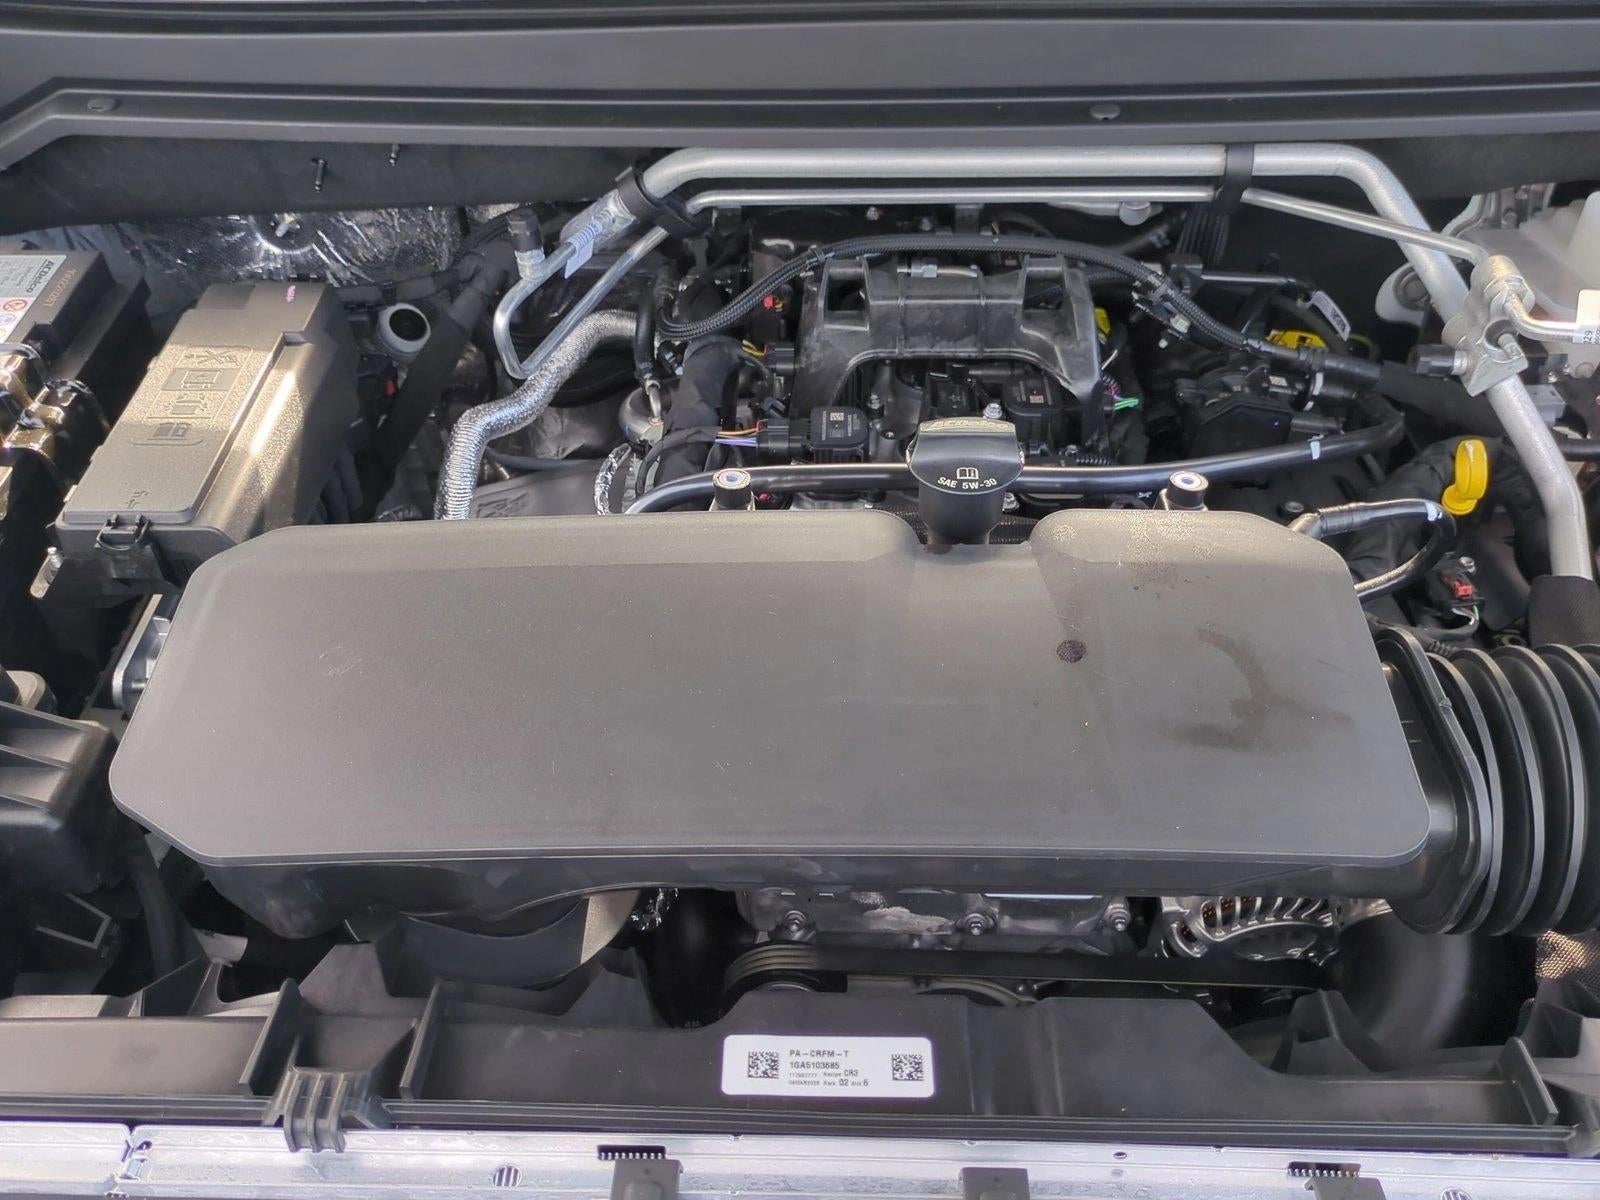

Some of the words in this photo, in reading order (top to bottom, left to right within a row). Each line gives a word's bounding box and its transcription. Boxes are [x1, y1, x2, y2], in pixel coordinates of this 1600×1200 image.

[26, 260, 54, 293] ACDelco
[937, 476, 958, 488] SAE
[962, 478, 997, 490] 5W-30
[790, 1061, 840, 1070] 1GA5103685
[843, 1069, 859, 1077] CR3
[838, 1078, 849, 1087] 02
[862, 1078, 869, 1087] 6
